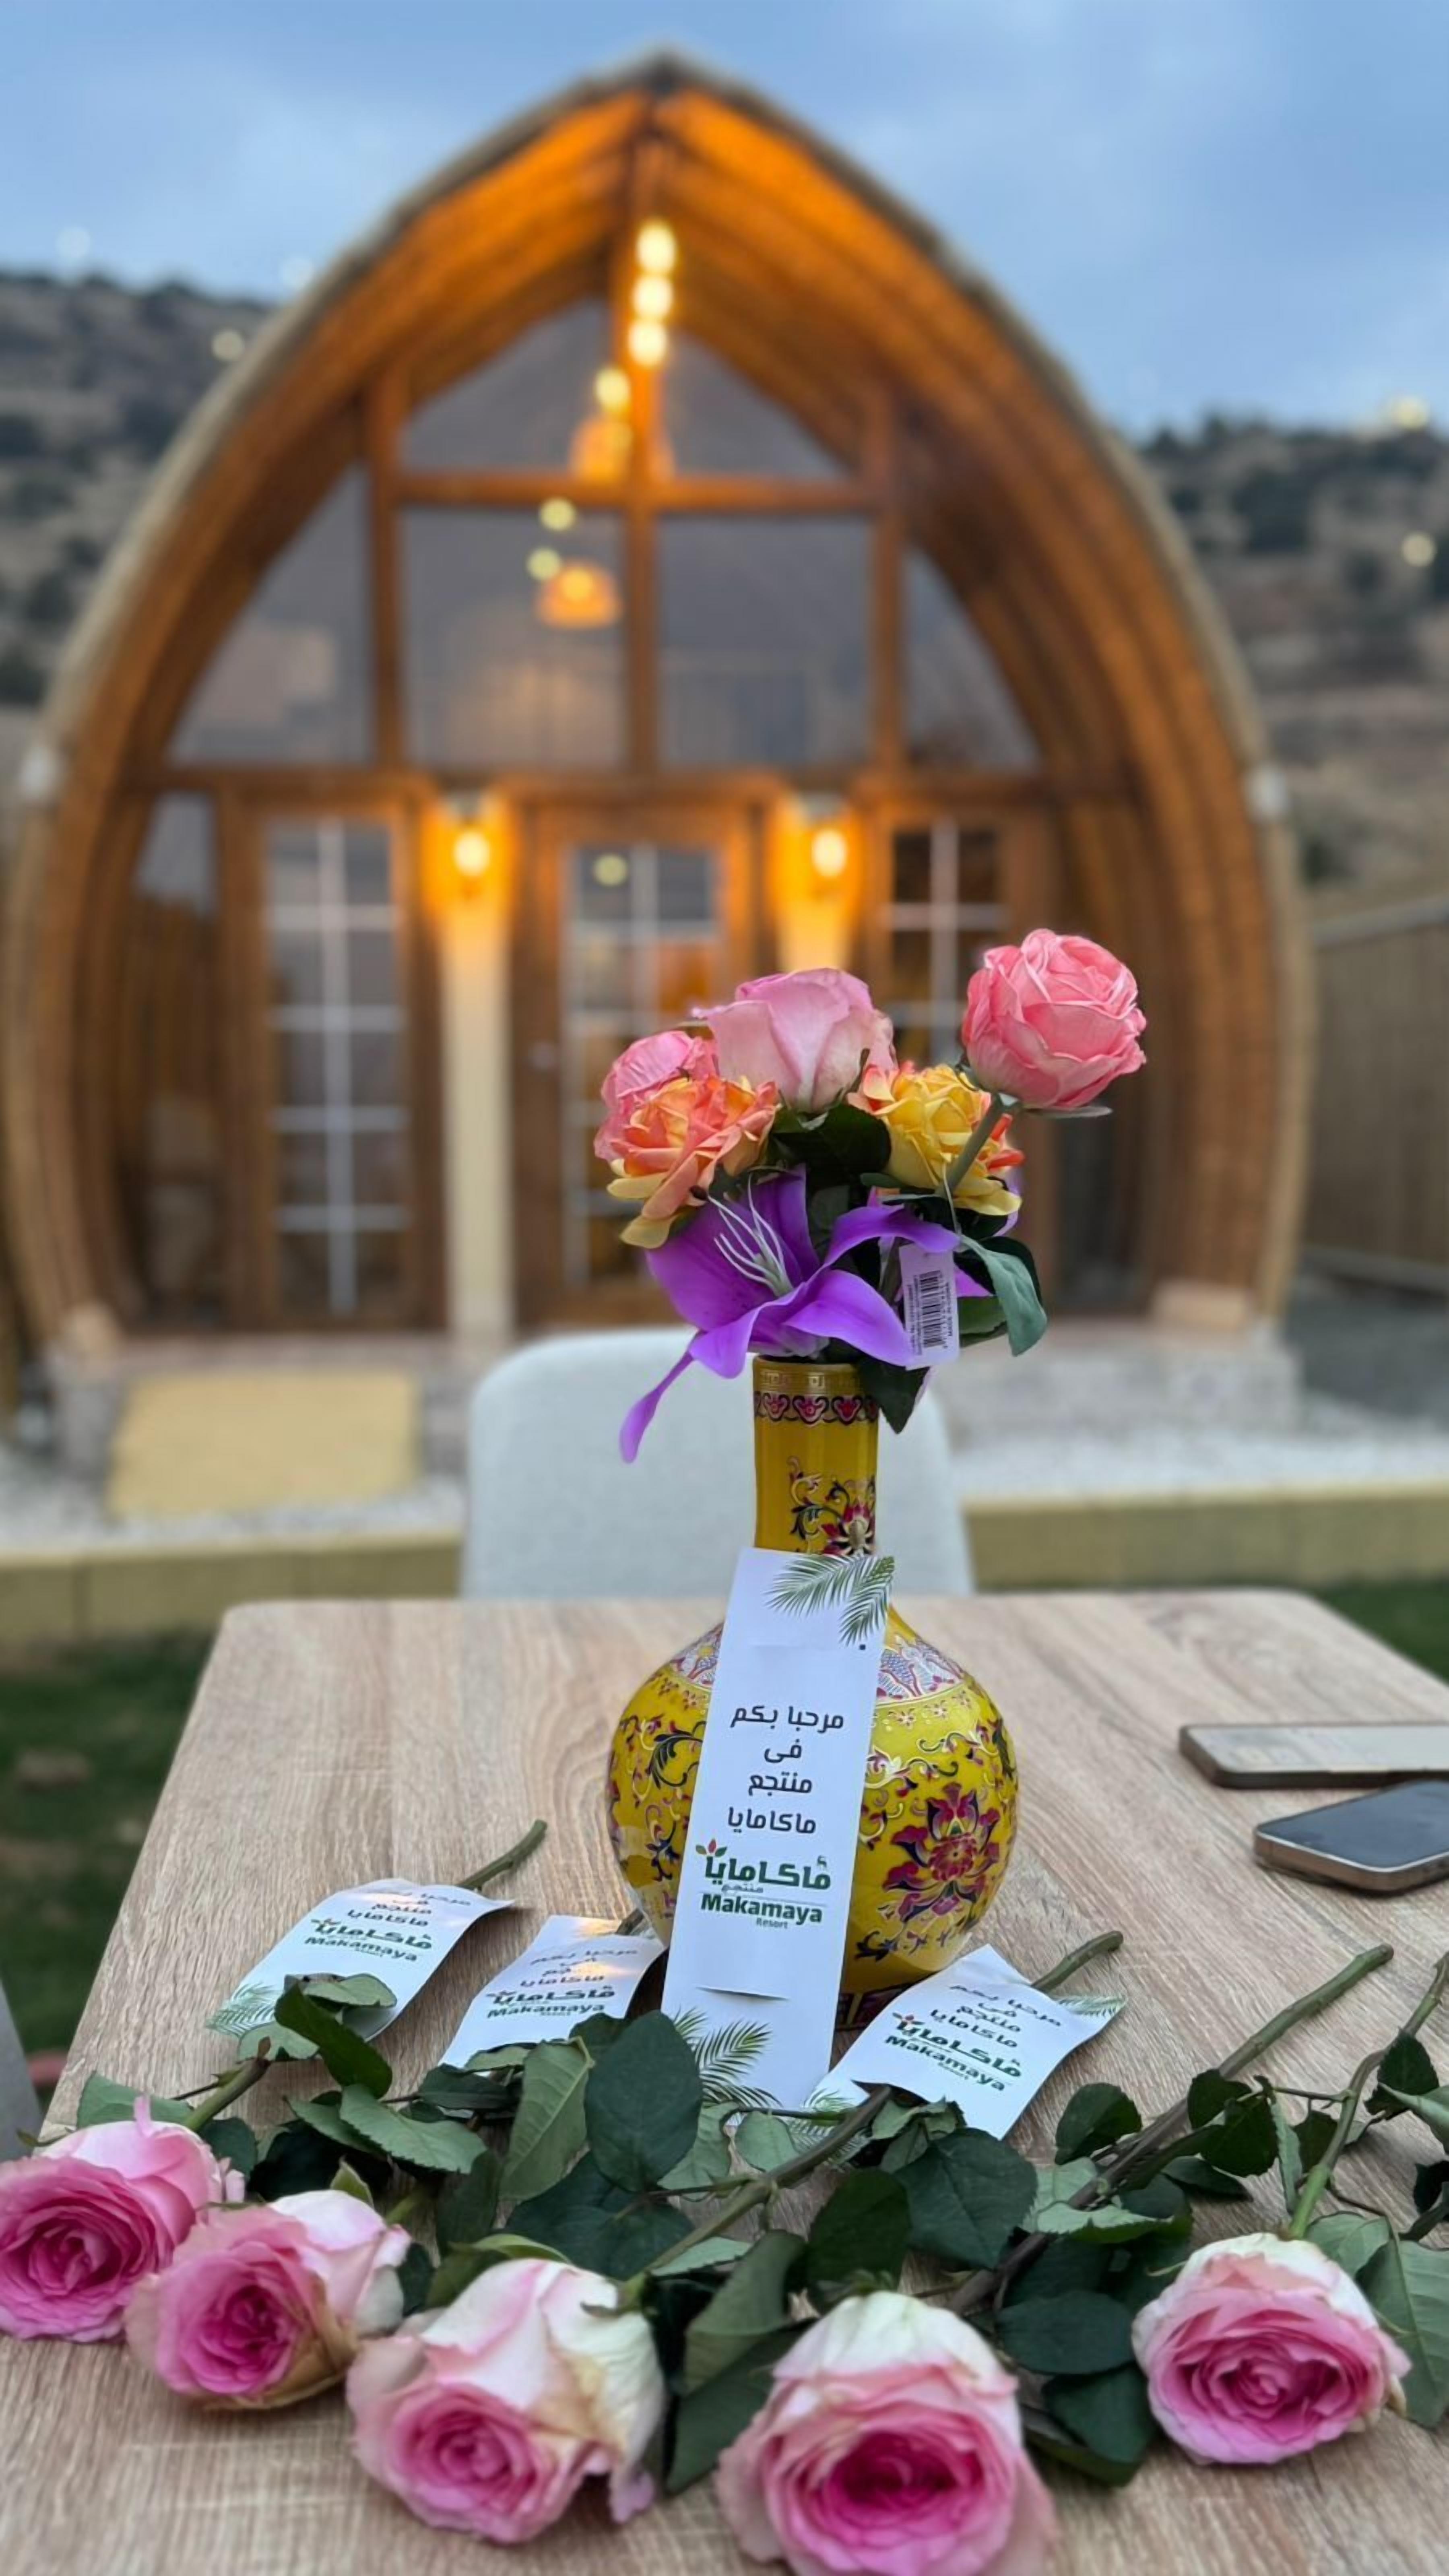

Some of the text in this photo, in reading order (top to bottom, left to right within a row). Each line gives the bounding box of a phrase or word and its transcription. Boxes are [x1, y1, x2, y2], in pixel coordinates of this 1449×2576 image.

[729, 1705, 844, 1734] مرحبا بكم
[748, 1771, 813, 1796] منتجع
[728, 1806, 816, 1834] ماكامايا
[705, 1855, 831, 1890] ماكامايا
[347, 1909, 429, 1927] ماكامايا
[701, 1893, 823, 1925] Makamaya
[756, 1917, 788, 1929] Resort
[305, 1936, 417, 1962] Makamaya
[487, 2004, 605, 2019] Makamaya
[931, 2009, 1017, 2048] ماكامايا
[885, 2035, 1005, 2091] Makamaya
